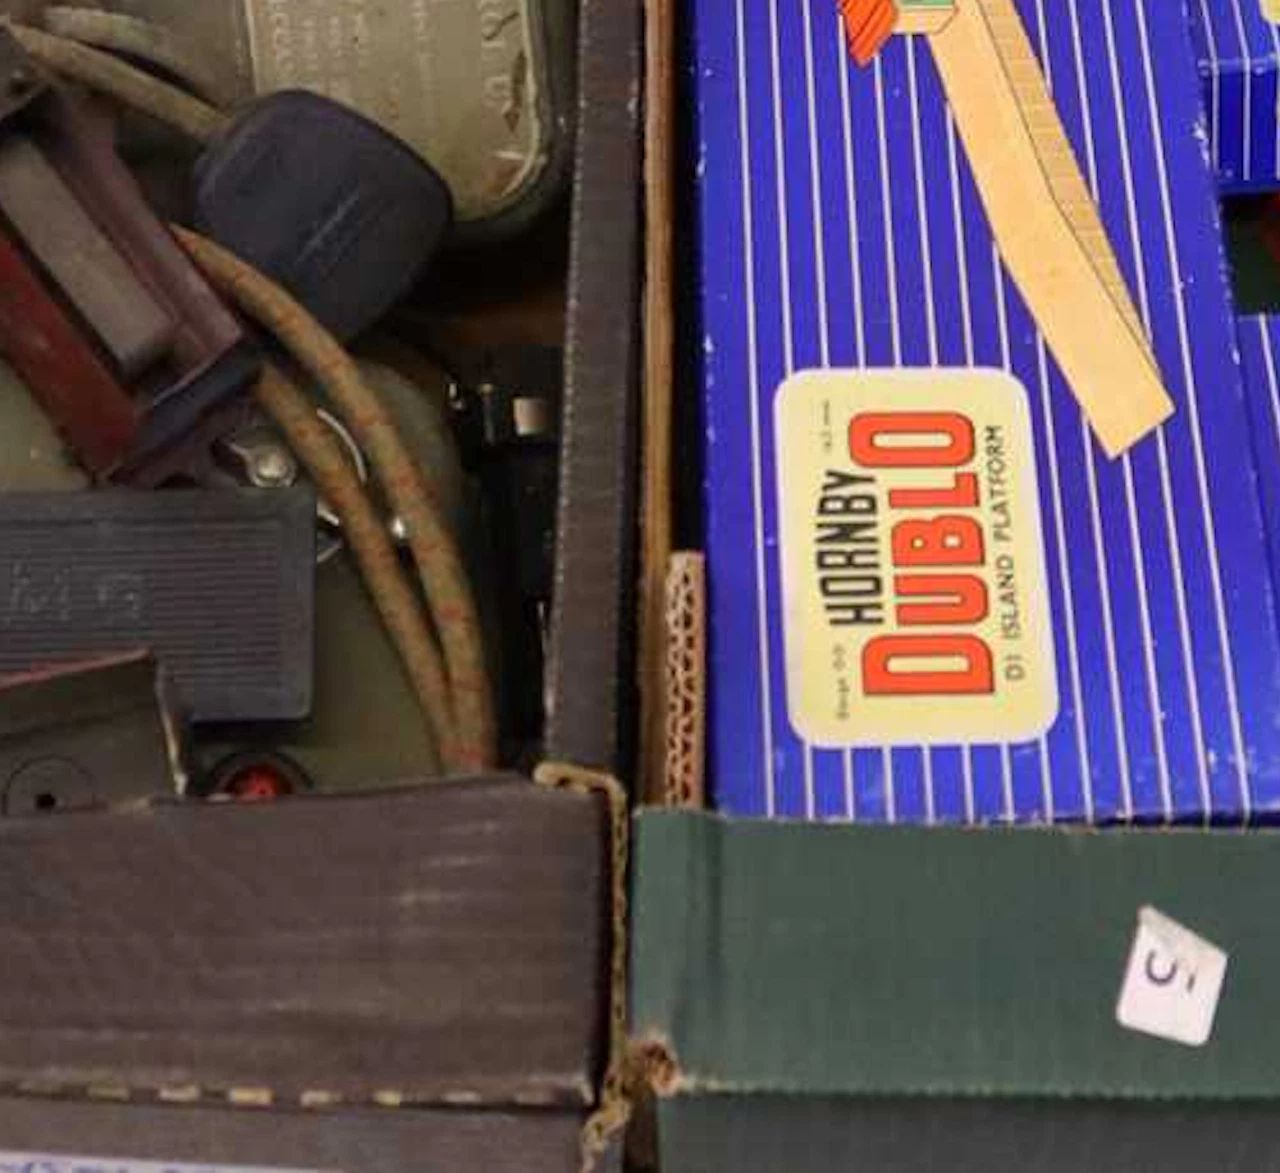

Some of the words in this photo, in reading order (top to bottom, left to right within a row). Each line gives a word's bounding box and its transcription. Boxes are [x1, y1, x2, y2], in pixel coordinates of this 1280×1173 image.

[815, 469, 884, 626] HORNBY
[985, 424, 1011, 539] PLATFORM
[848, 410, 995, 696] DUBLO
[991, 554, 1021, 640] ISLAND
